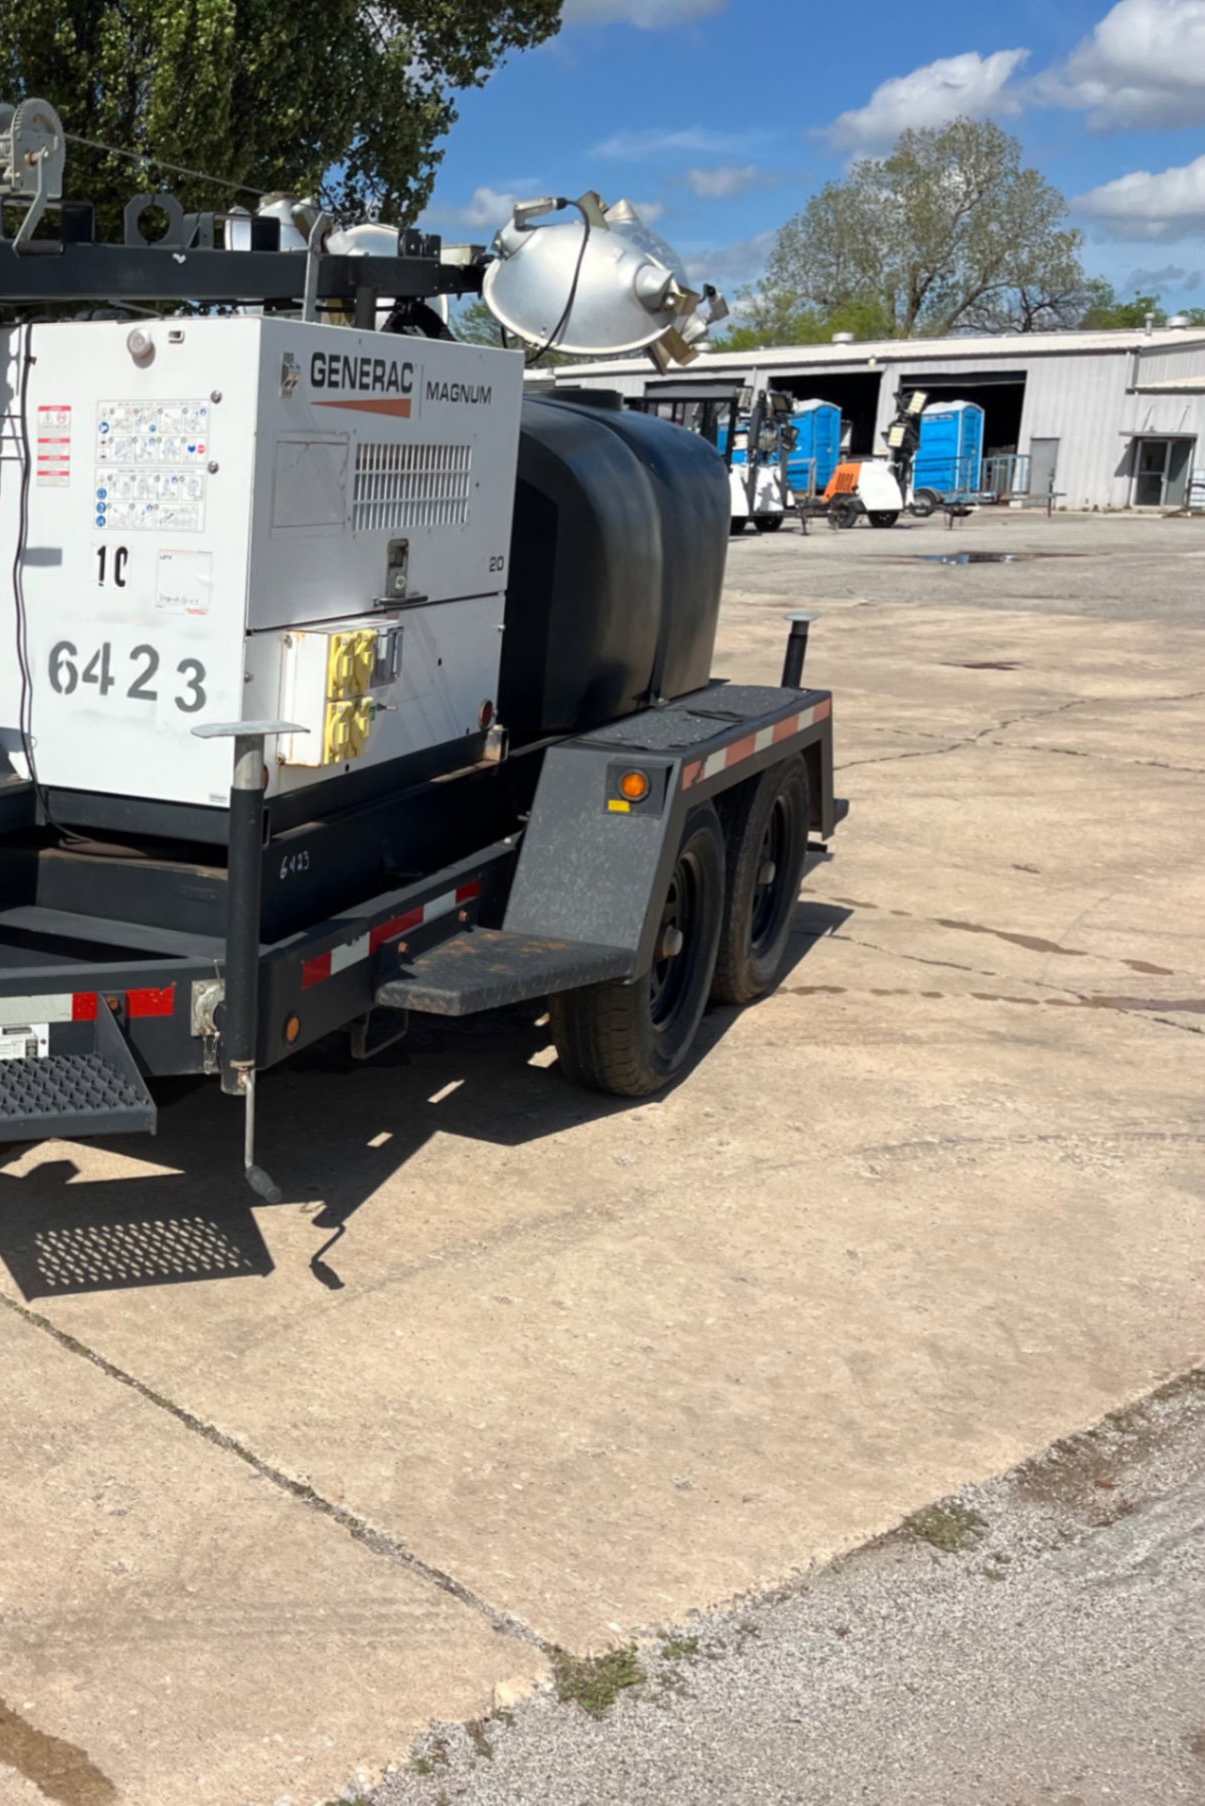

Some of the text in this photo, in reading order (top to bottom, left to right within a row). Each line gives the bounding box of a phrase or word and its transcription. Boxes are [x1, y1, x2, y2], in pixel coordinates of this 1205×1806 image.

[311, 351, 492, 405] GENERAC MAGNUM
[489, 555, 504, 573] 20
[48, 640, 208, 714] 6423
[279, 850, 310, 880] 6423
